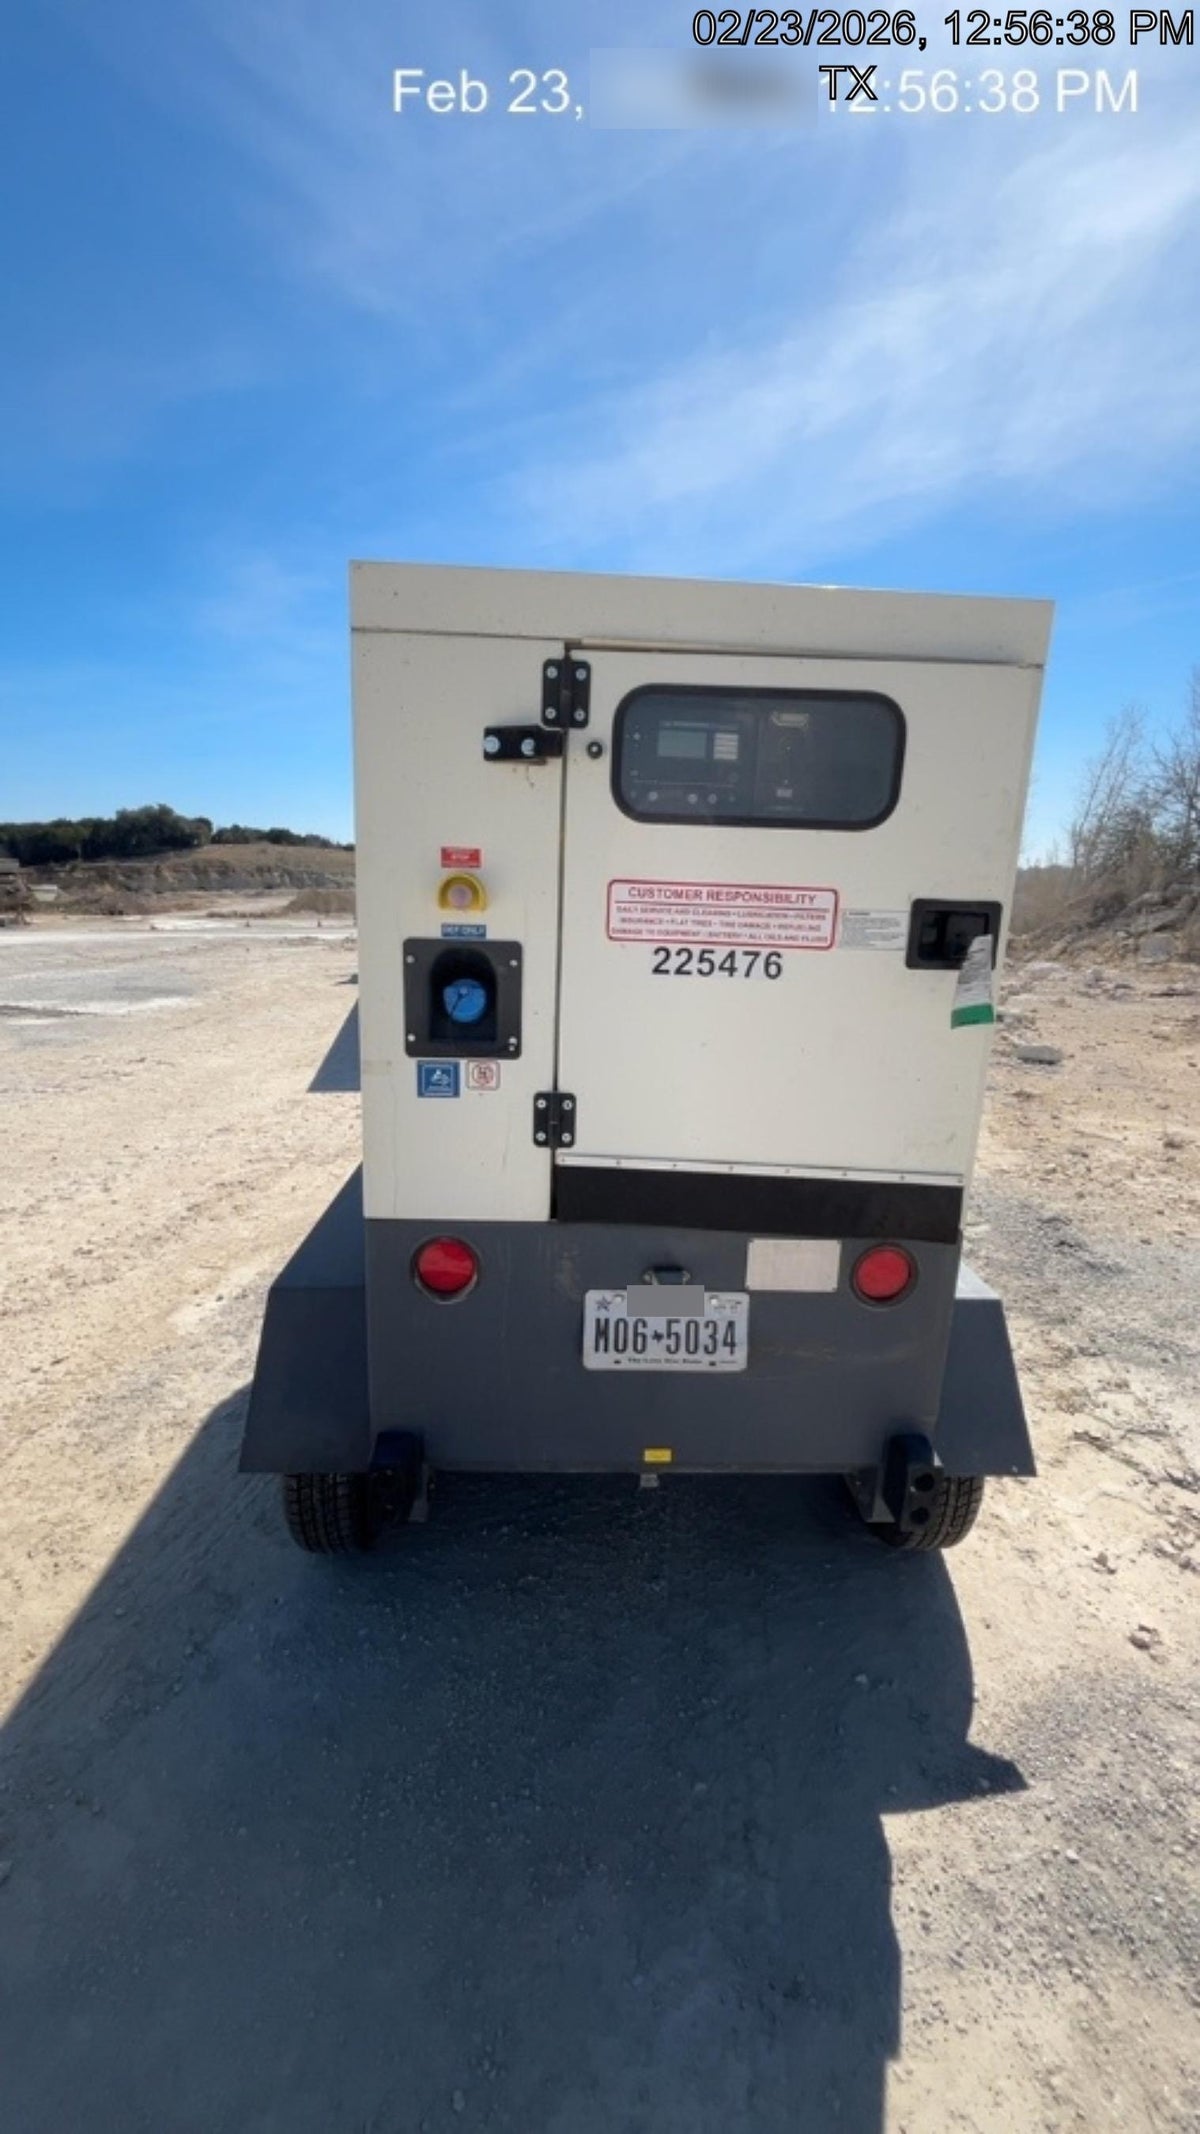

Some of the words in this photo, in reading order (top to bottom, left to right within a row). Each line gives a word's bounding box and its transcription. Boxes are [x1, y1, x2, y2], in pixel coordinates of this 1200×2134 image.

[628, 886, 703, 900] CUSTOMER
[706, 889, 817, 905] RESPONSIBILITY
[651, 946, 783, 979] 225476
[666, 1318, 737, 1356] 5034
